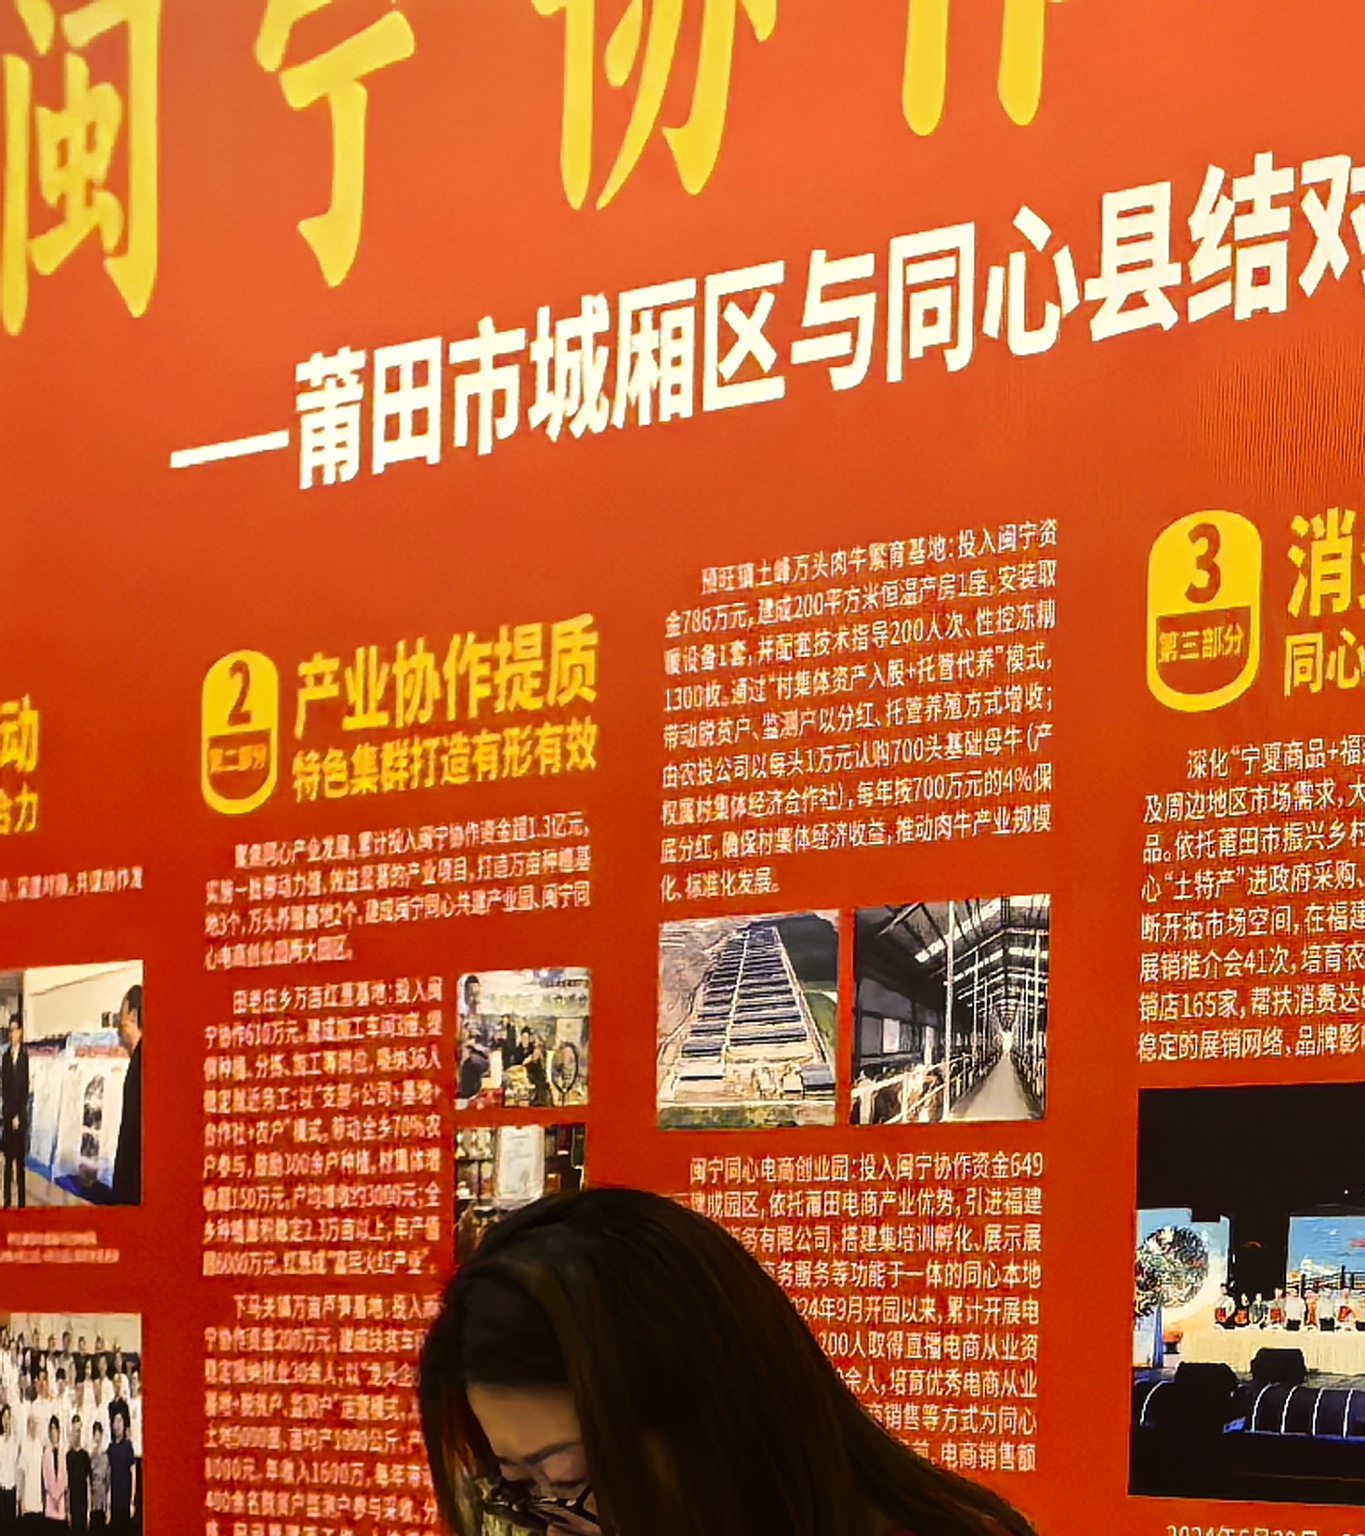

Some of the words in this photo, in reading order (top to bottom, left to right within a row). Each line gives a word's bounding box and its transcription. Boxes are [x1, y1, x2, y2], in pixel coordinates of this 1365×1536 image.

[0, 0, 1060, 336] 闽宁协
[1185, 522, 1221, 604] 3
[294, 613, 599, 740] 产业协作提质
[1157, 624, 1244, 664] 第三部分
[227, 660, 253, 727] 2
[292, 716, 598, 803] 特色集群打造有形有效
